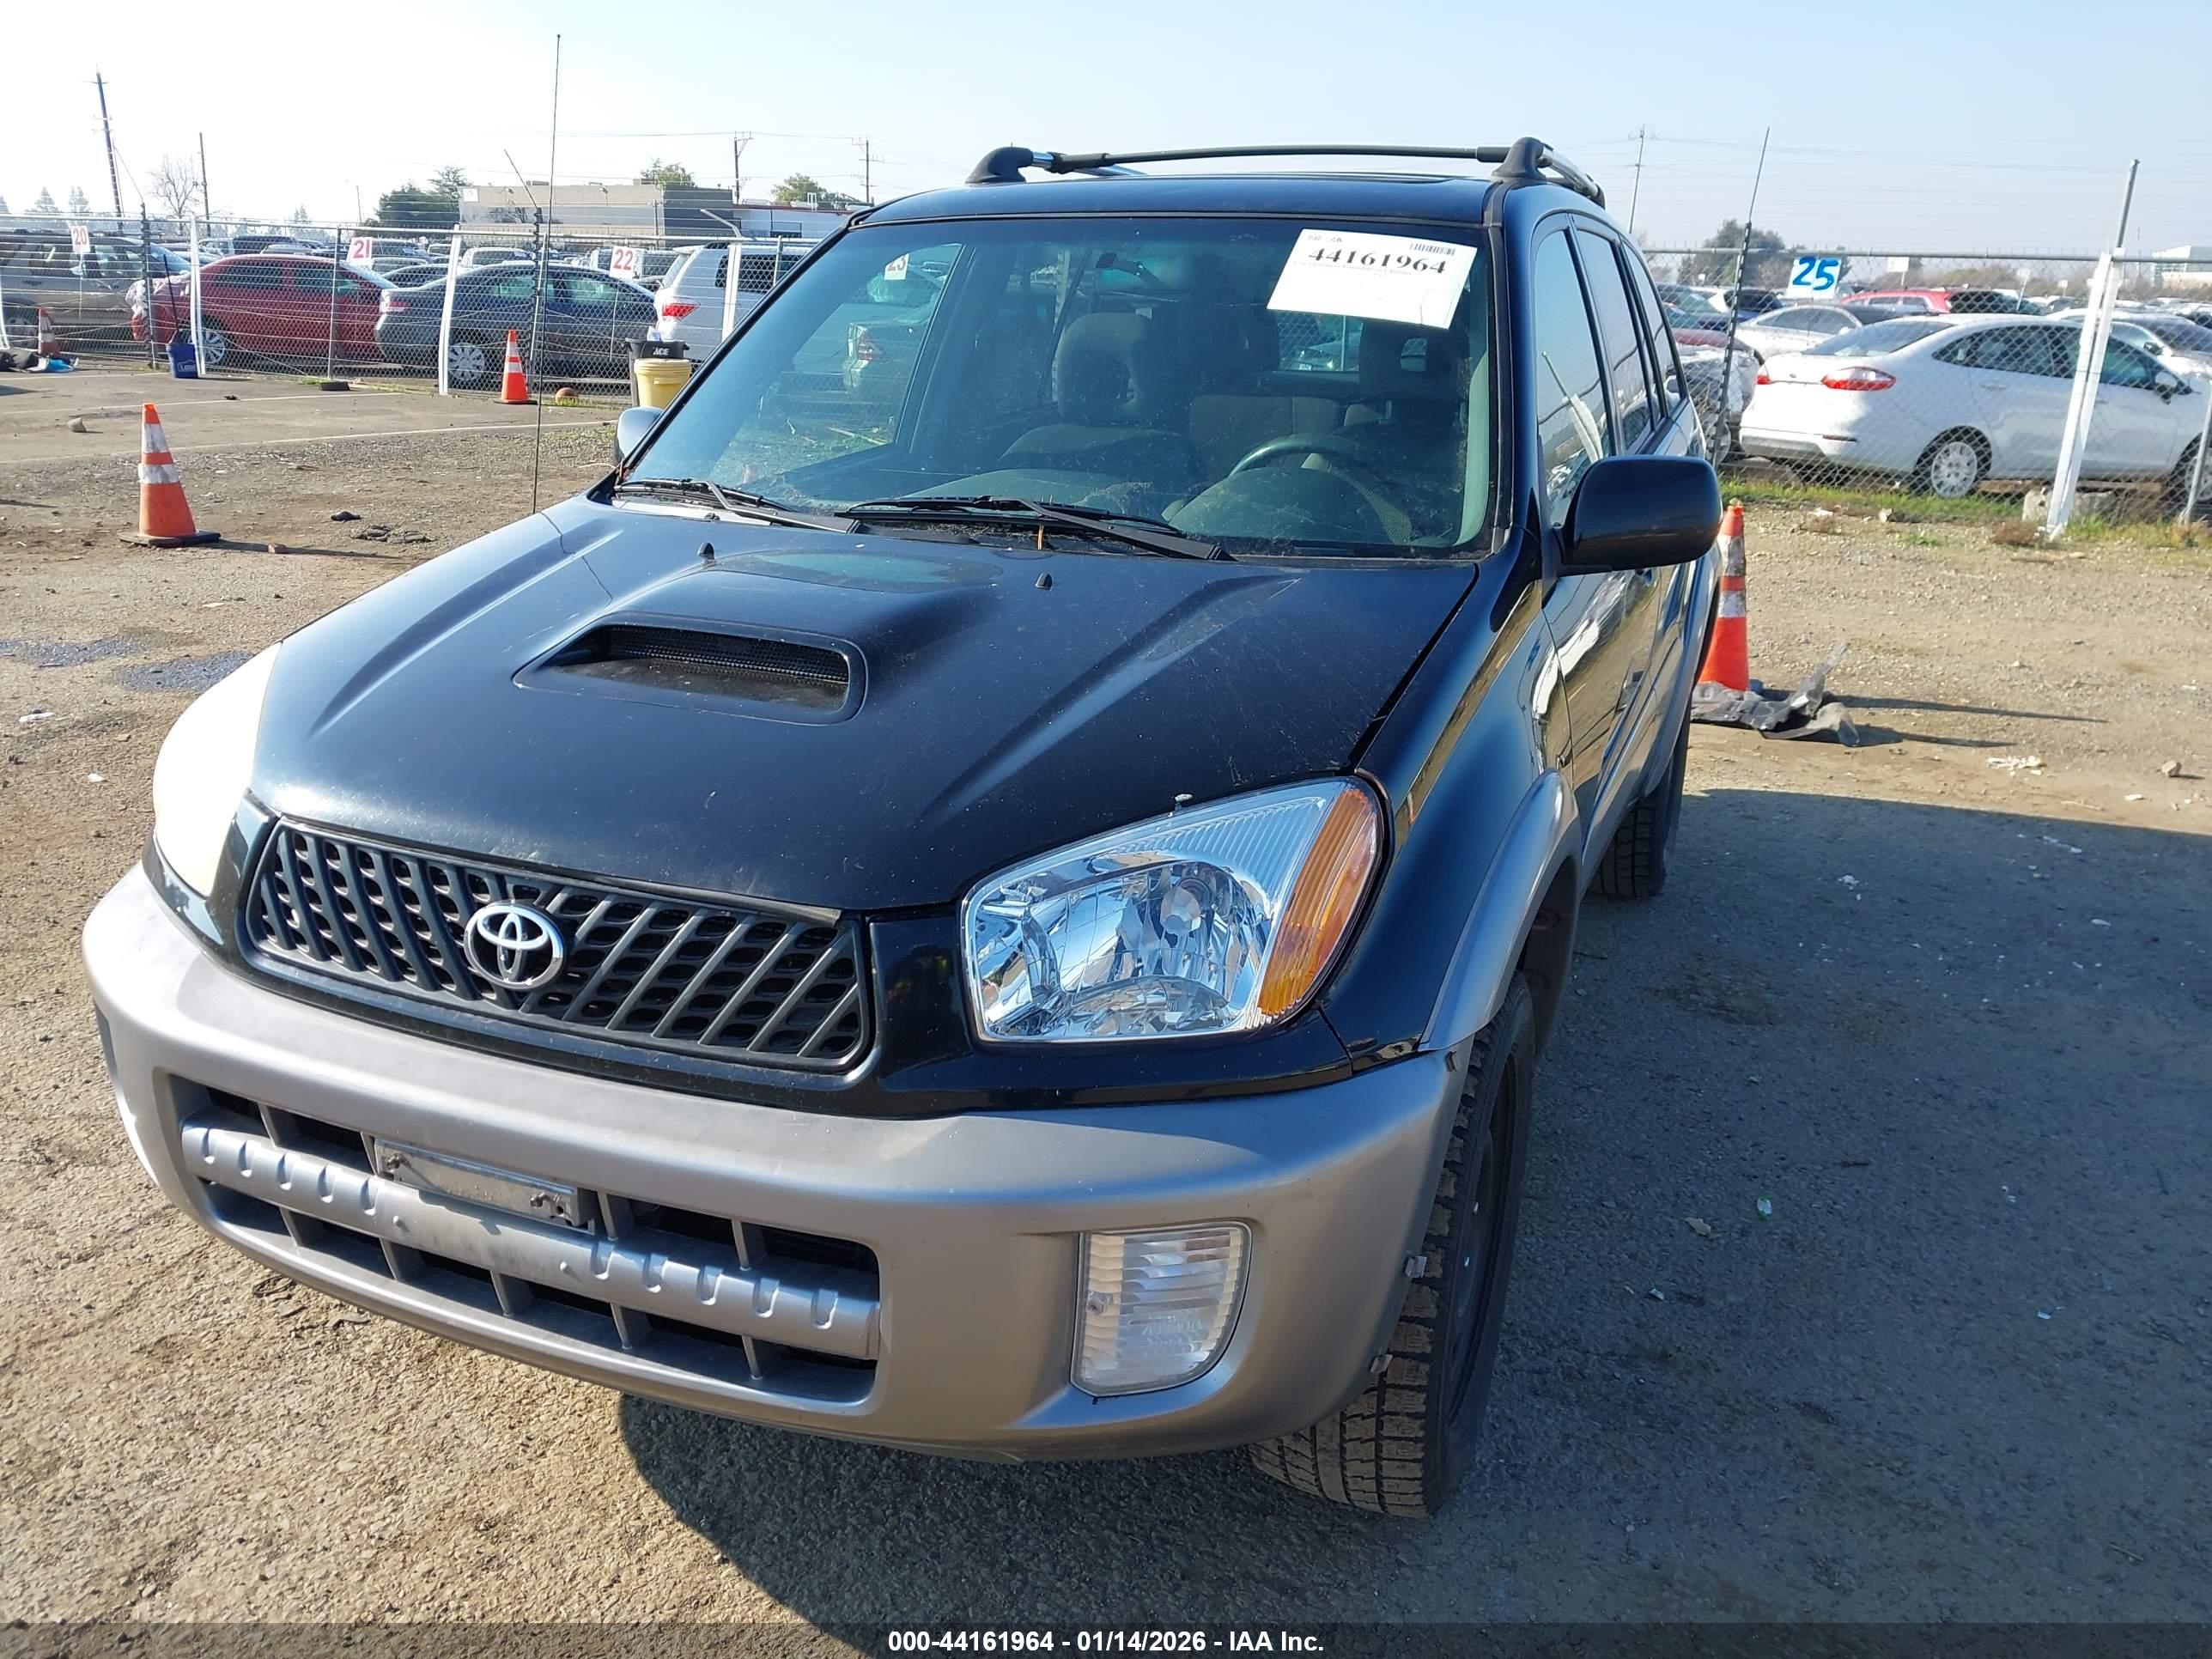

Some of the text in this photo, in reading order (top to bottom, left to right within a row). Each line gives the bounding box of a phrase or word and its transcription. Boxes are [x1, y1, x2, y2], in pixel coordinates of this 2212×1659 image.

[73, 228, 87, 246] 20
[353, 239, 370, 258] 21
[612, 249, 634, 270] 22
[1308, 247, 1447, 274] 44161964
[1792, 256, 1839, 290] 25
[652, 348, 669, 356] ACE
